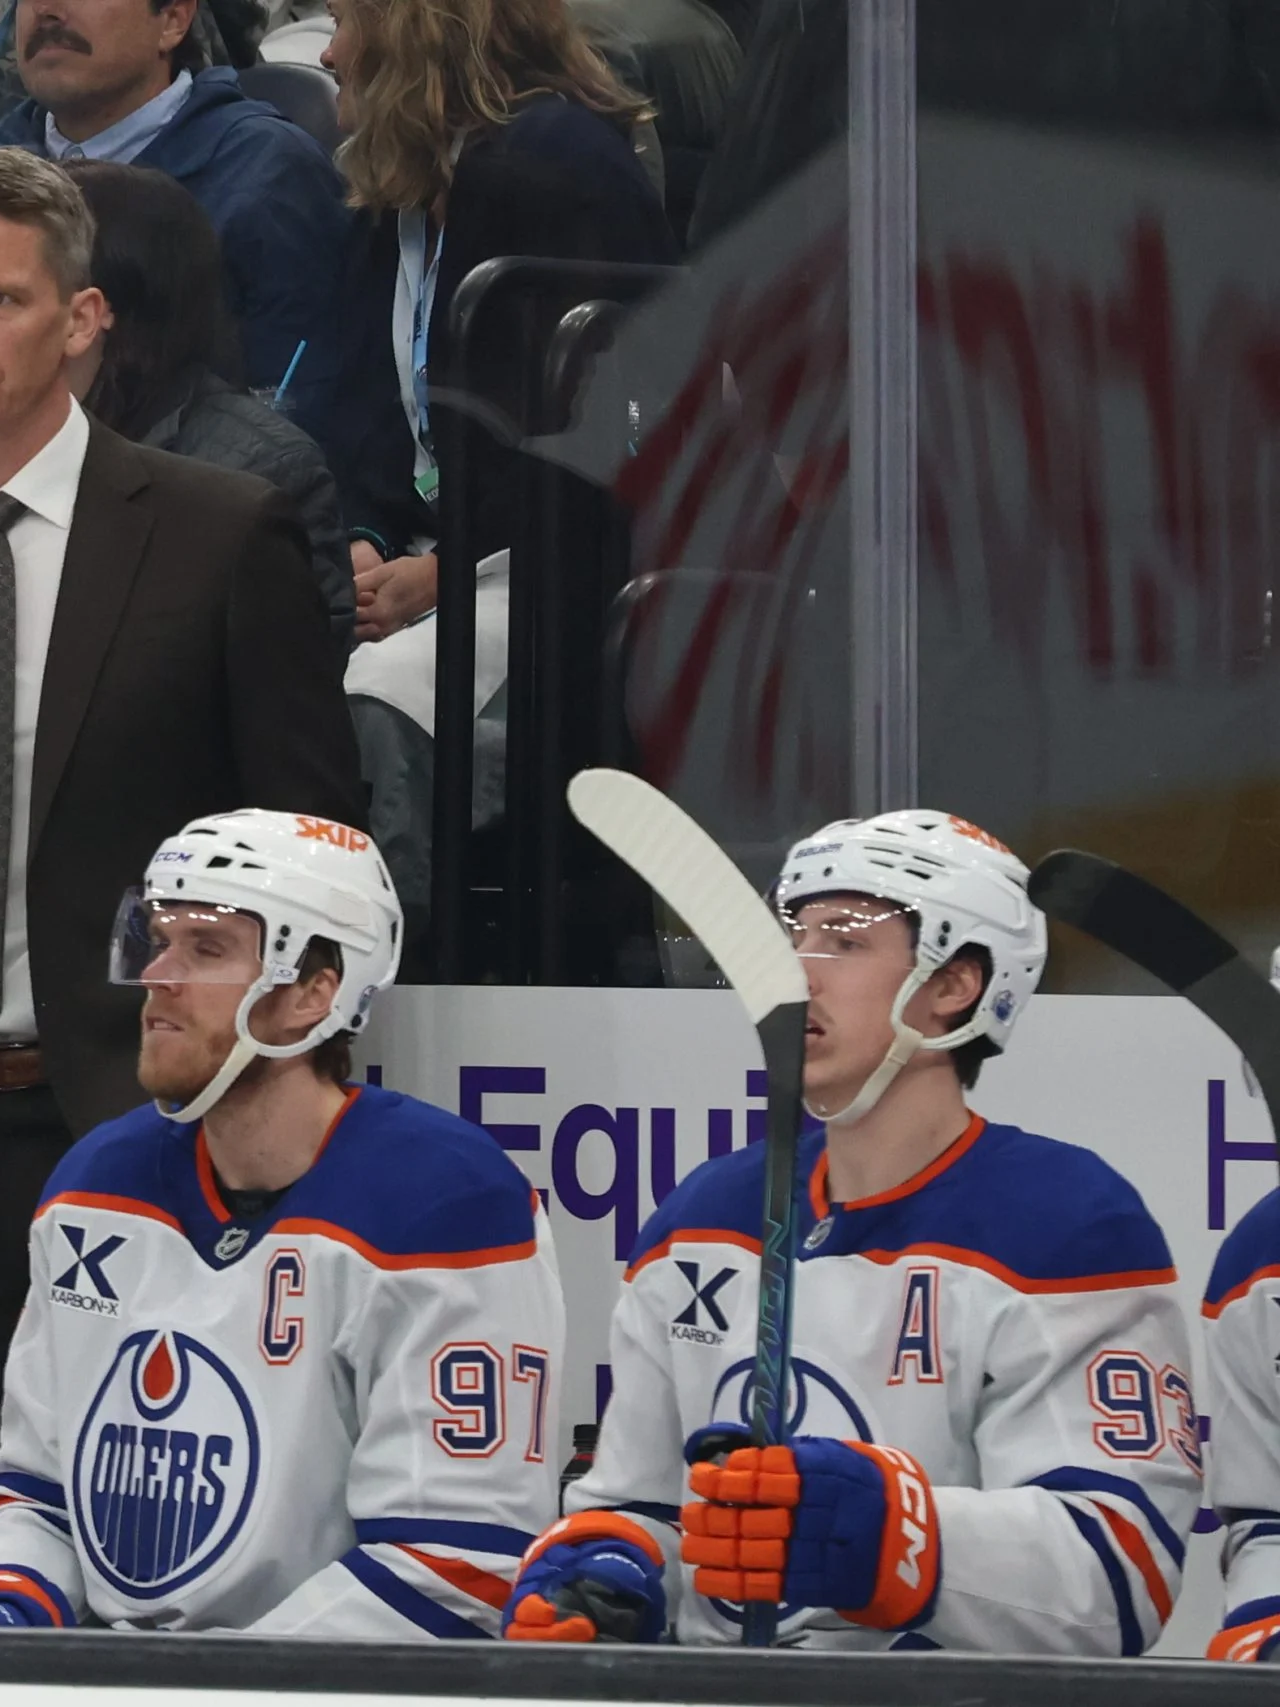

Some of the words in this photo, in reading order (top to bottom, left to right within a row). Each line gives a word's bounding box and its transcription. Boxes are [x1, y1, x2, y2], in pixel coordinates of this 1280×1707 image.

[154, 852, 194, 863] CCM
[295, 816, 368, 853] SKIP
[50, 1288, 119, 1315] KARBON-X
[258, 1247, 306, 1366] C
[888, 1266, 943, 1386] A
[430, 1341, 550, 1464] 97
[1087, 1350, 1205, 1479] 93
[91, 1423, 233, 1507] OILERS
[871, 1444, 927, 1590] CCM
